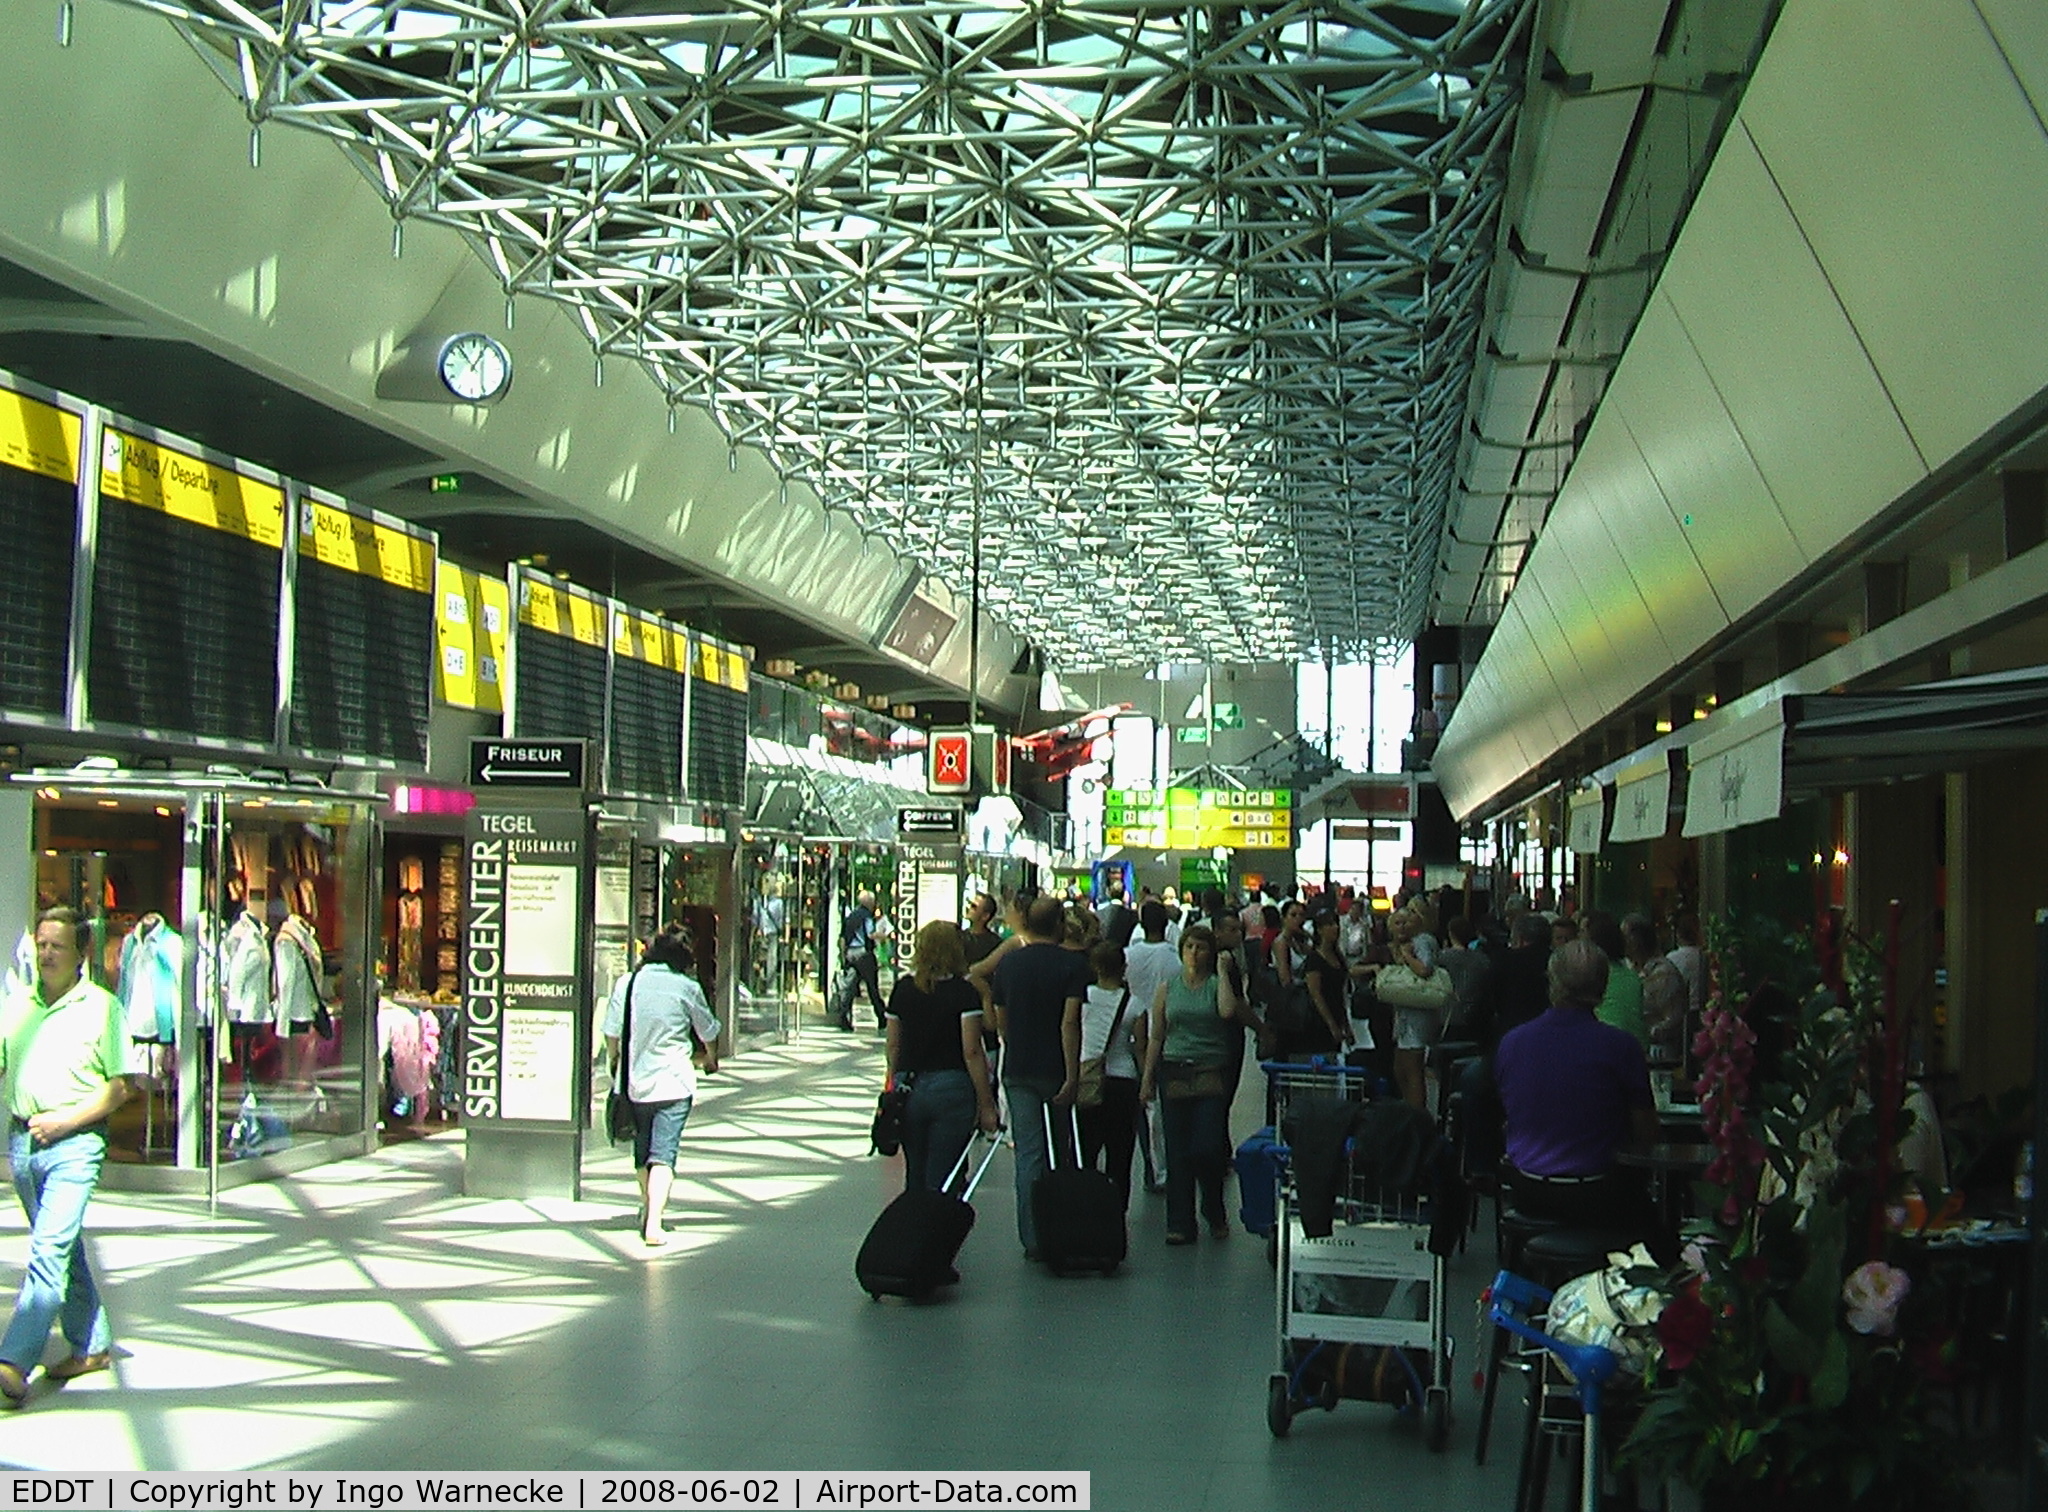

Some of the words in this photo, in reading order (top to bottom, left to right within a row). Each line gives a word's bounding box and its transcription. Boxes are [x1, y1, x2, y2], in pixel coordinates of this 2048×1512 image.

[170, 459, 219, 496] Departure
[488, 746, 562, 762] FRISEUR
[481, 814, 536, 835] TEGEL
[507, 839, 577, 853] REISEMARKT
[903, 846, 935, 859] TEGEL
[898, 860, 917, 980] VICECENTER
[465, 838, 502, 1118] SERVICECENTER
[503, 983, 573, 997] KUNDENDIENST
